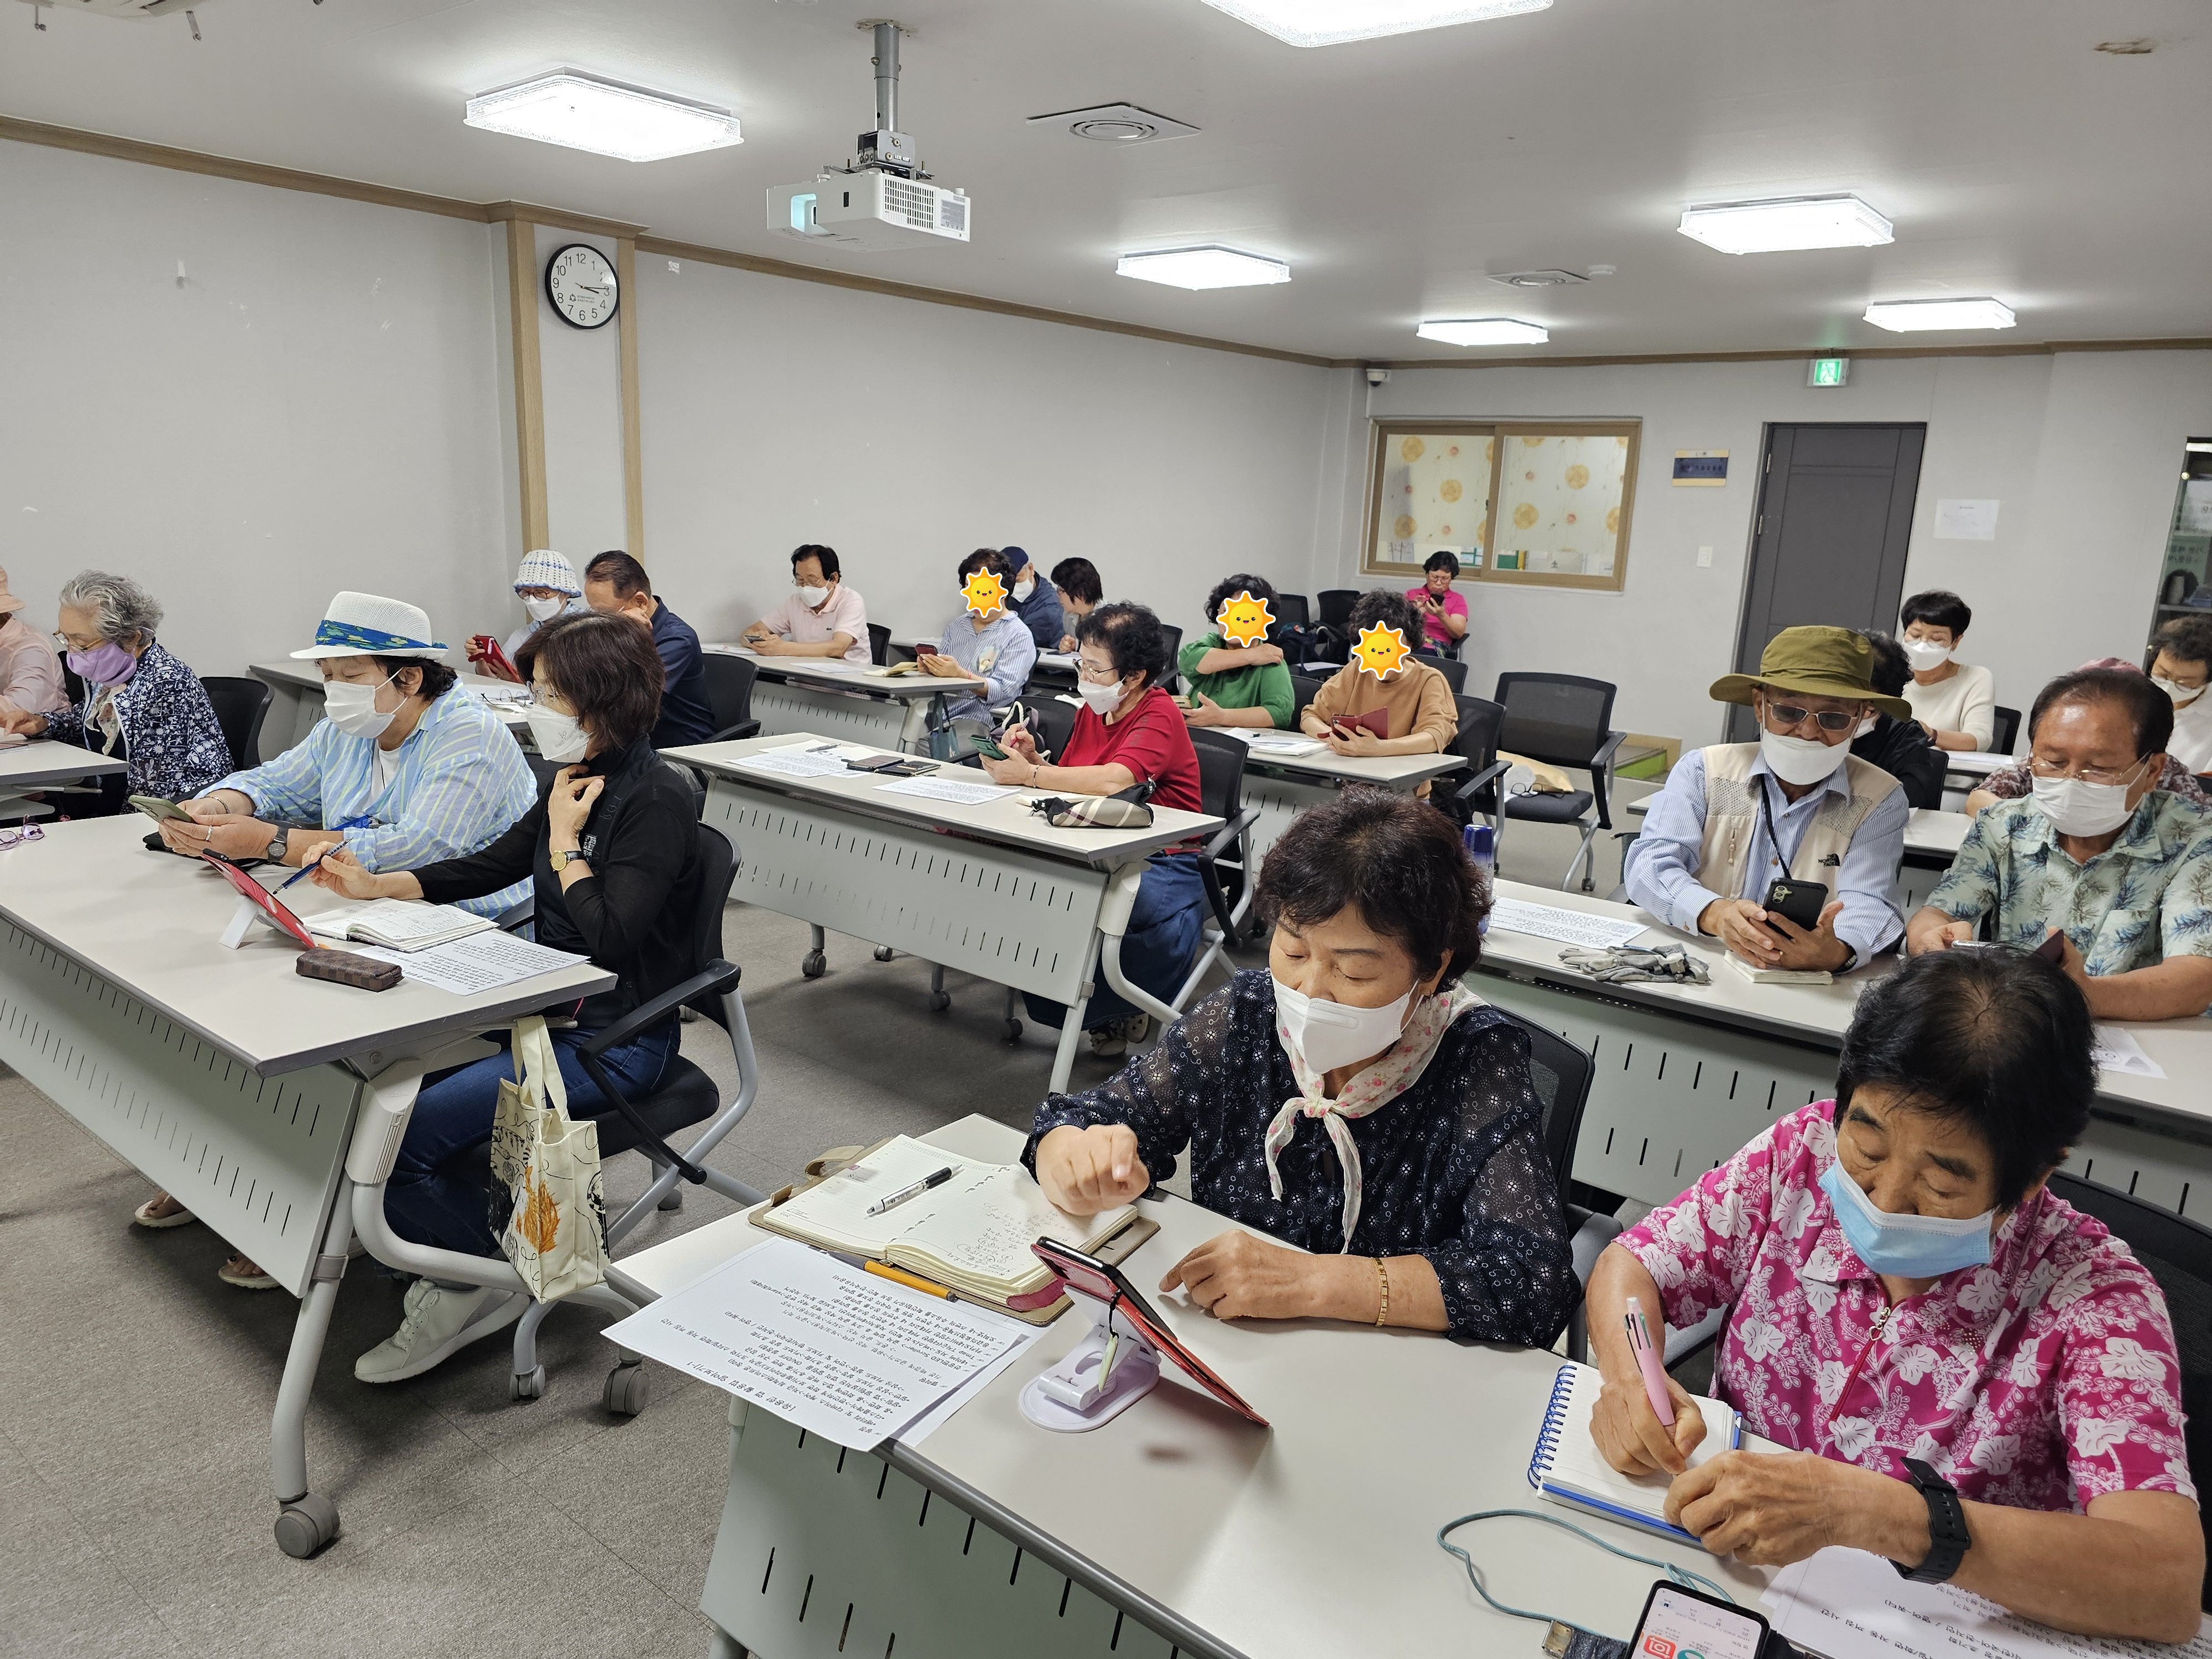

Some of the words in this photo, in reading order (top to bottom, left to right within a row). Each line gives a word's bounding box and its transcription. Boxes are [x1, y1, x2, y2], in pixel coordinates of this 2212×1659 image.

[564, 255, 572, 266] 11
[576, 253, 586, 264] 12
[556, 265, 566, 276] 10
[591, 260, 596, 270] 1
[600, 272, 606, 282] 2
[553, 278, 560, 288] 9
[604, 285, 610, 296] 3
[557, 293, 564, 304] 8
[567, 304, 574, 315] 7
[599, 299, 607, 310] 4
[579, 310, 586, 321] 6
[592, 308, 598, 319] 5
[1819, 1608, 1840, 1621] 시간
[1845, 1619, 1865, 1632] 꺼짐
[1869, 1630, 1889, 1643] 자동
